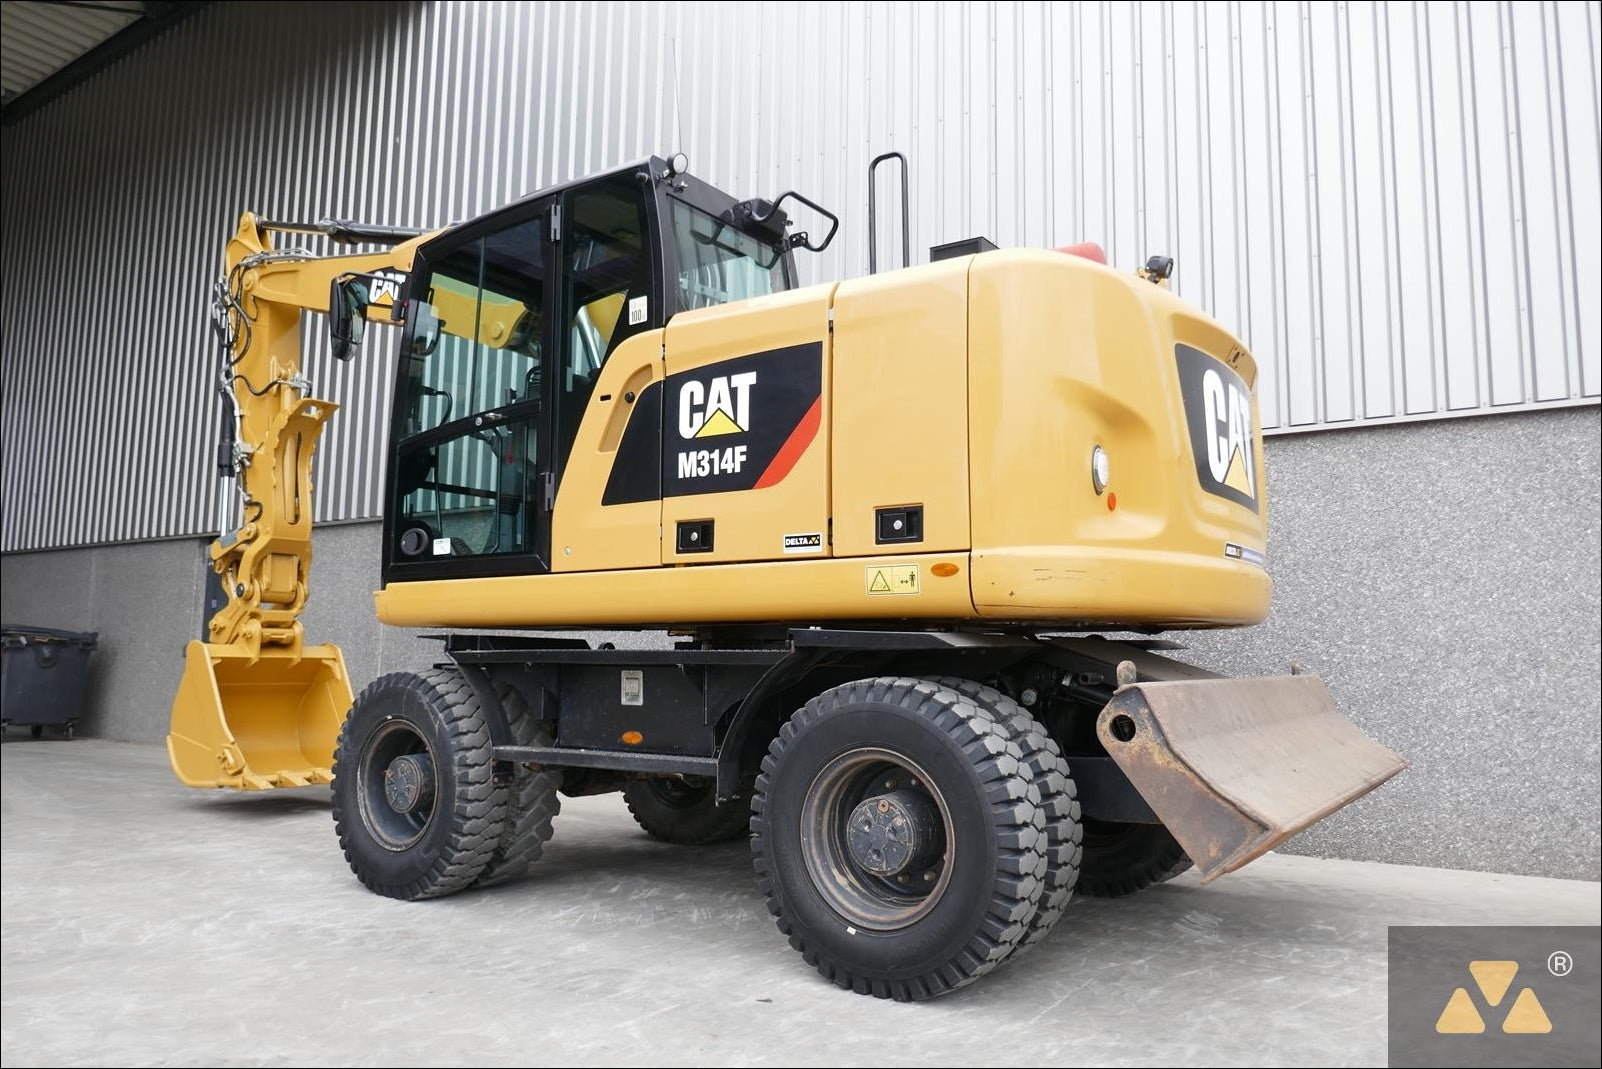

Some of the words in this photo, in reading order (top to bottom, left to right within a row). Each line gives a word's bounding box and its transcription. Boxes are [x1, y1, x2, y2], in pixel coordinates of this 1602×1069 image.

[369, 270, 407, 303] CAT
[631, 308, 642, 322] 100
[678, 370, 757, 440] CAT
[1203, 368, 1255, 500] CAT
[678, 445, 748, 479] M314F
[785, 537, 809, 546] DELTA
